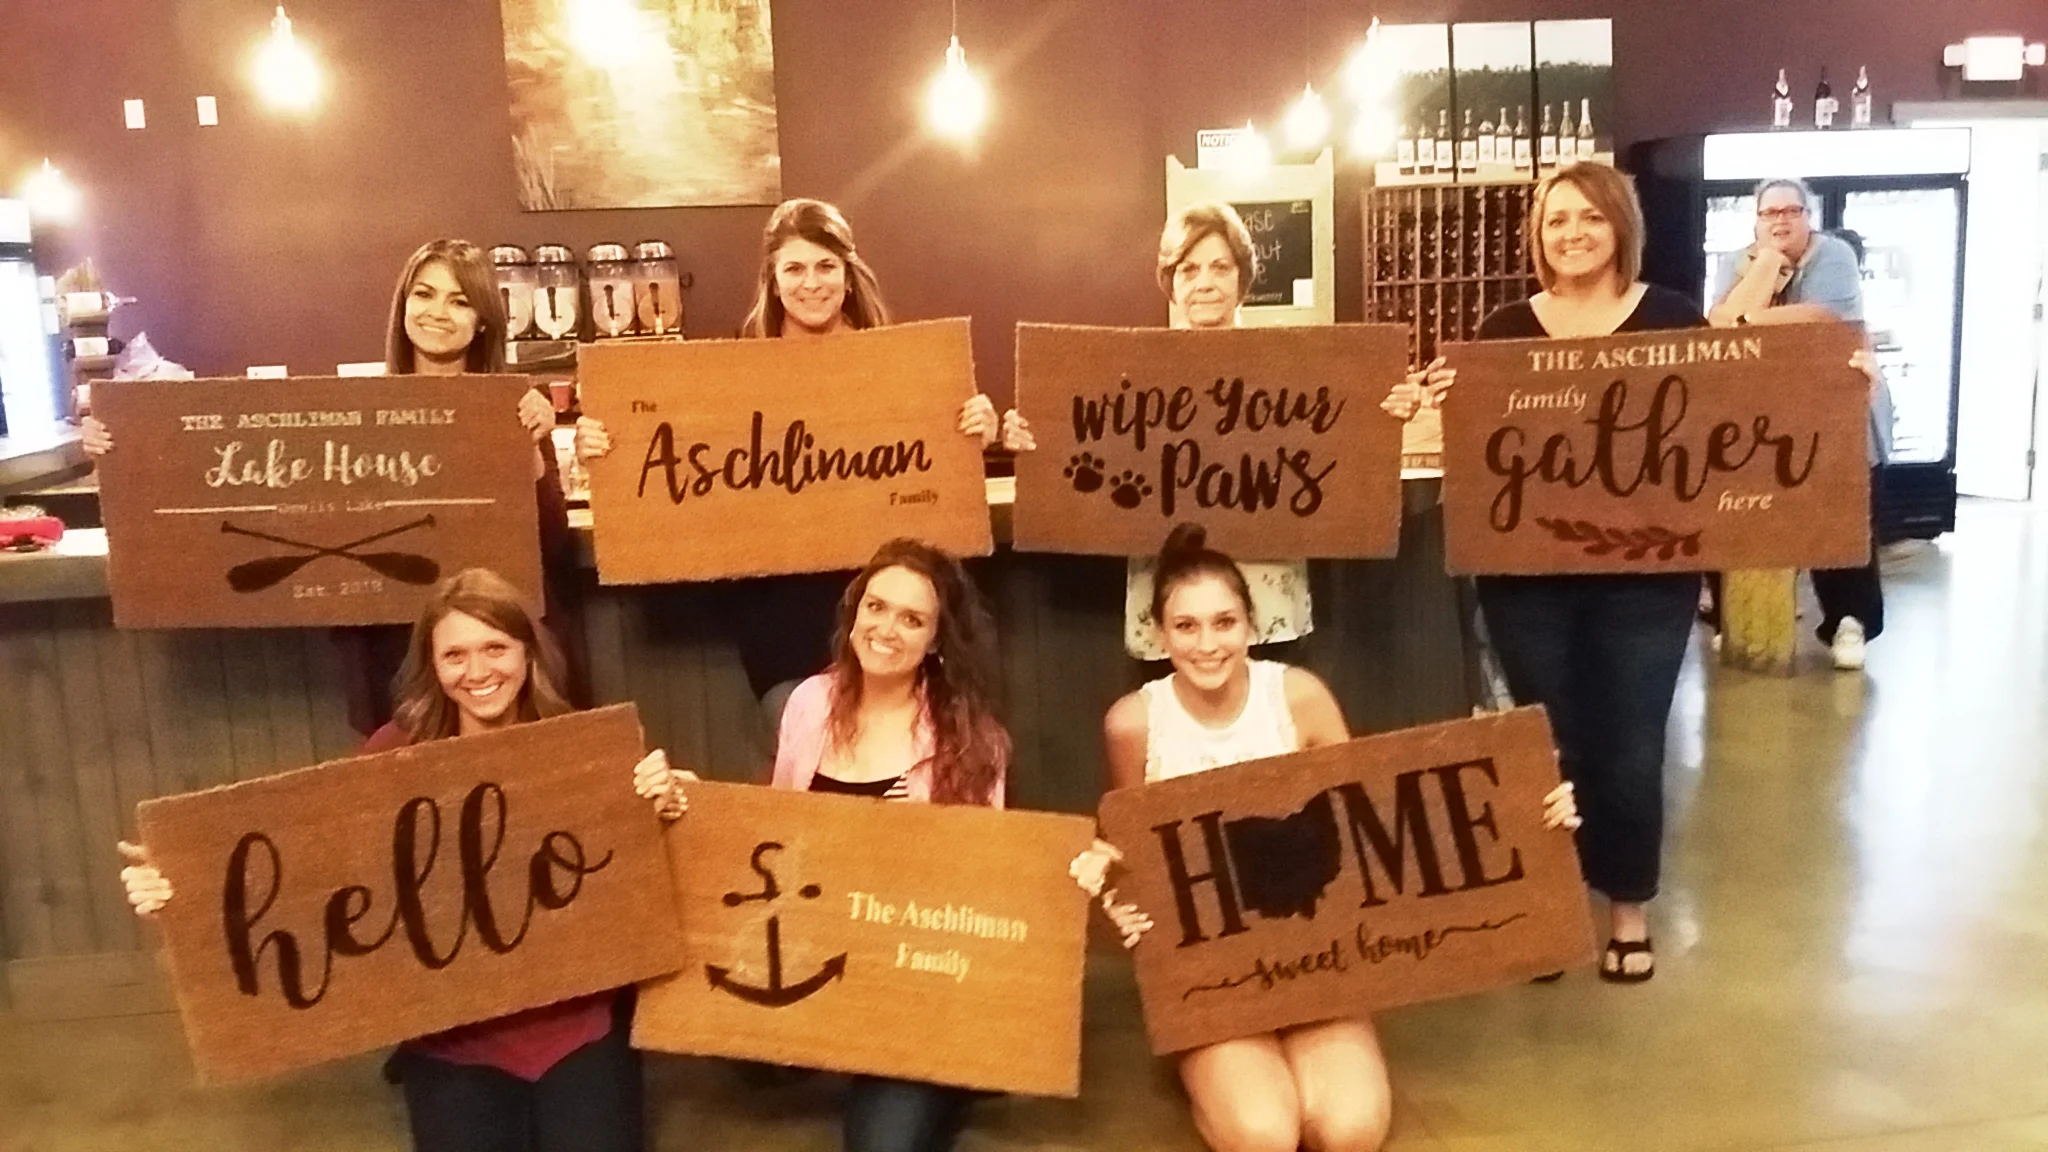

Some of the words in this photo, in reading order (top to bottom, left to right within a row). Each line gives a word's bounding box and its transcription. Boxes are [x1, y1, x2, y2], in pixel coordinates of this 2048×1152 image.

[1528, 350, 1584, 373] THE
[1591, 337, 1763, 370] ASCHLIMAN
[180, 414, 223, 431] THE
[237, 410, 363, 429] ASCHLIMAN
[375, 408, 456, 426] FAMILY
[1072, 379, 1198, 451] wipe
[1502, 384, 1589, 418] family
[204, 437, 314, 488] Lake
[322, 439, 443, 486] House
[637, 410, 933, 505] Aschliman
[1485, 374, 1820, 533] gather
[888, 489, 940, 507] Family
[1717, 490, 1774, 512] here
[223, 782, 614, 1009] hello
[847, 891, 896, 924] The
[899, 899, 1029, 943] Aschliman
[894, 941, 972, 984] Family
[1246, 938, 1349, 991] sweet
[1356, 921, 1455, 968] home
